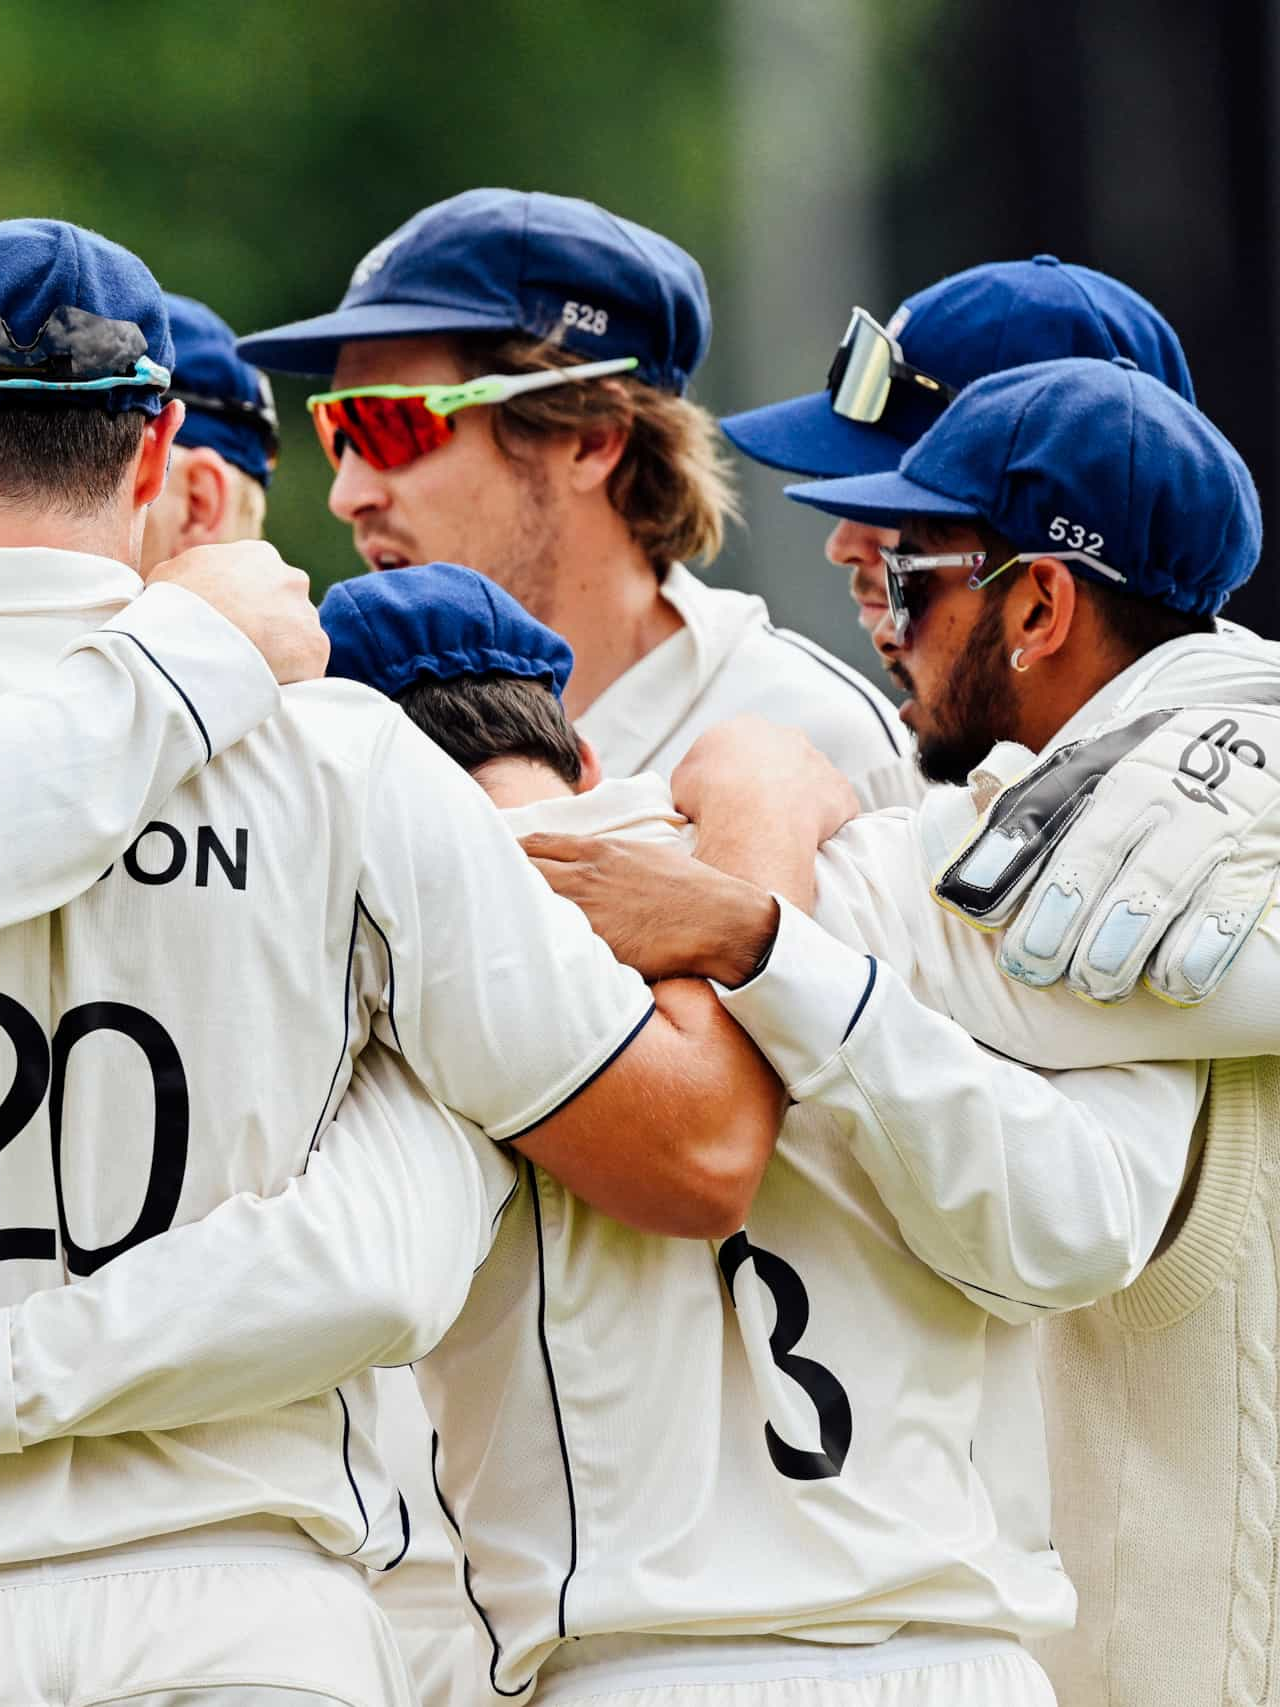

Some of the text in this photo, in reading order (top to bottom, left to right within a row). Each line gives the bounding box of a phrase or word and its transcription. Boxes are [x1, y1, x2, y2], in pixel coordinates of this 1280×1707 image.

[562, 300, 609, 336] 528
[1048, 516, 1104, 556] 532
[97, 820, 249, 891] ON
